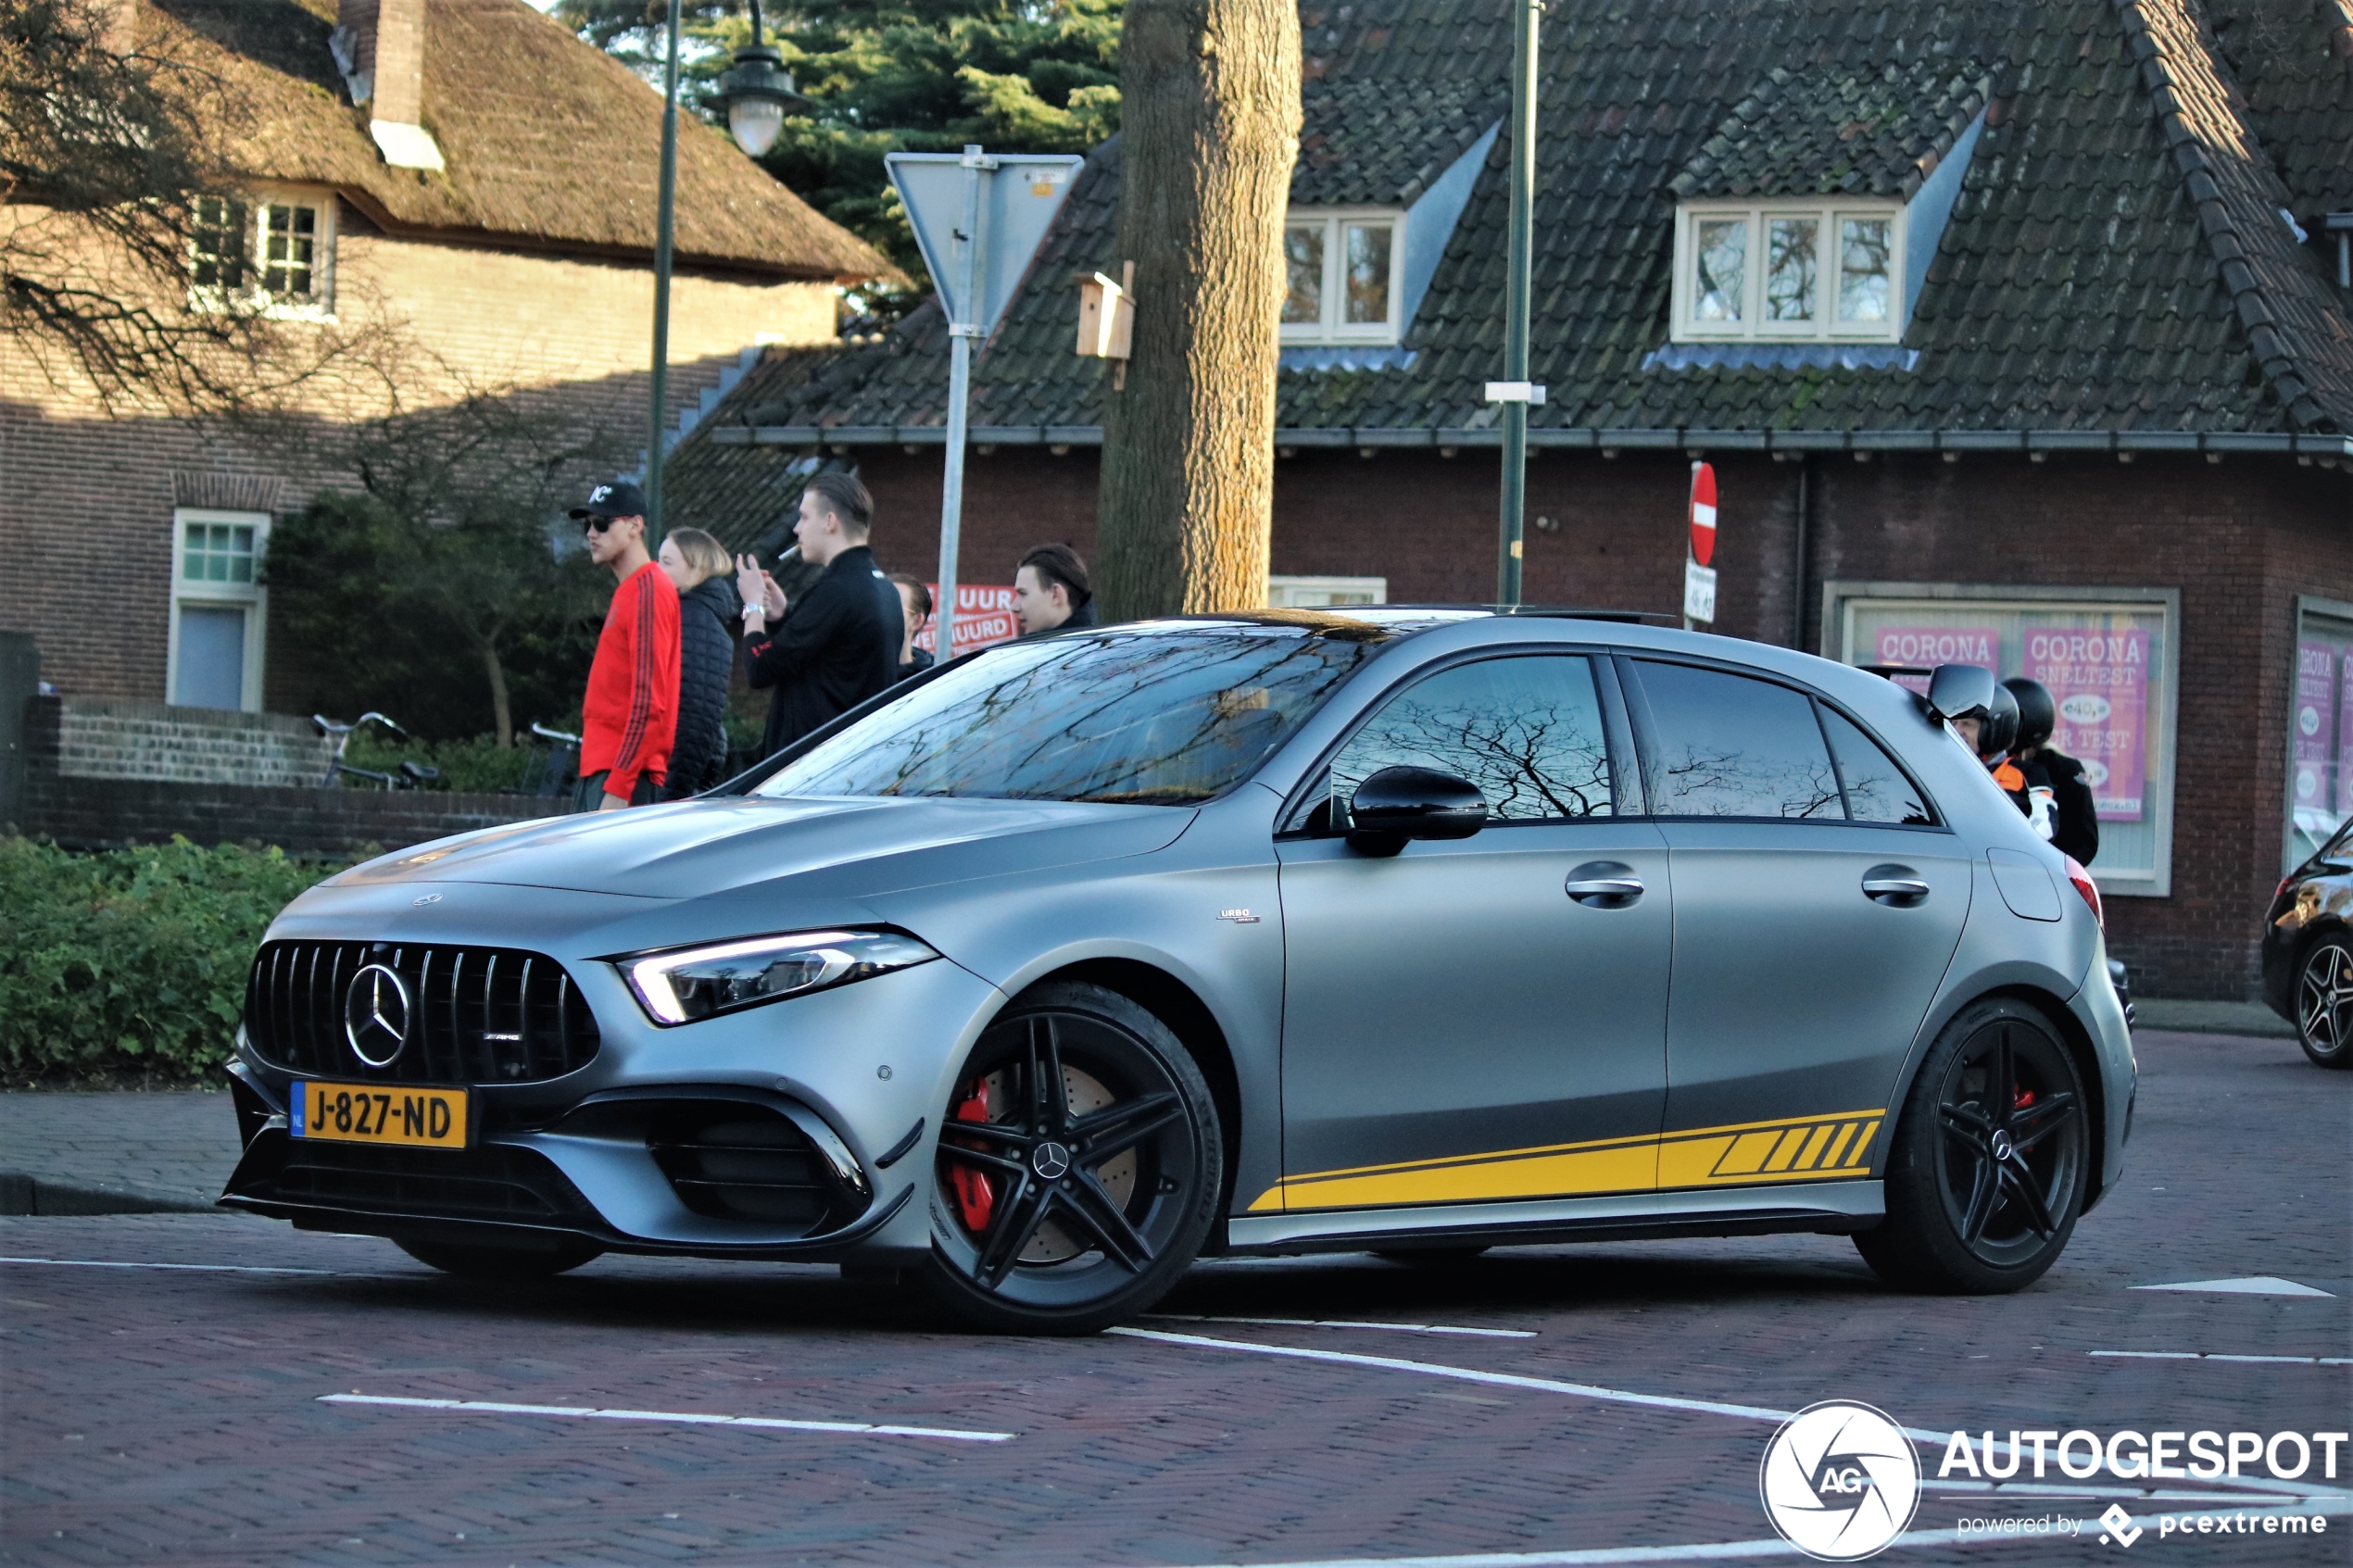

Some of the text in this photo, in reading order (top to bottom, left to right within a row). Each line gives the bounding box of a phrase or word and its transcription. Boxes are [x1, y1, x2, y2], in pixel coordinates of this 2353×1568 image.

[1882, 634, 1991, 662] CORONA
[2031, 635, 2141, 663] CORONA
[2035, 665, 2136, 685] SNELTEST
[2078, 729, 2130, 749] TEST
[293, 1090, 451, 1139] NL J-827-ND
